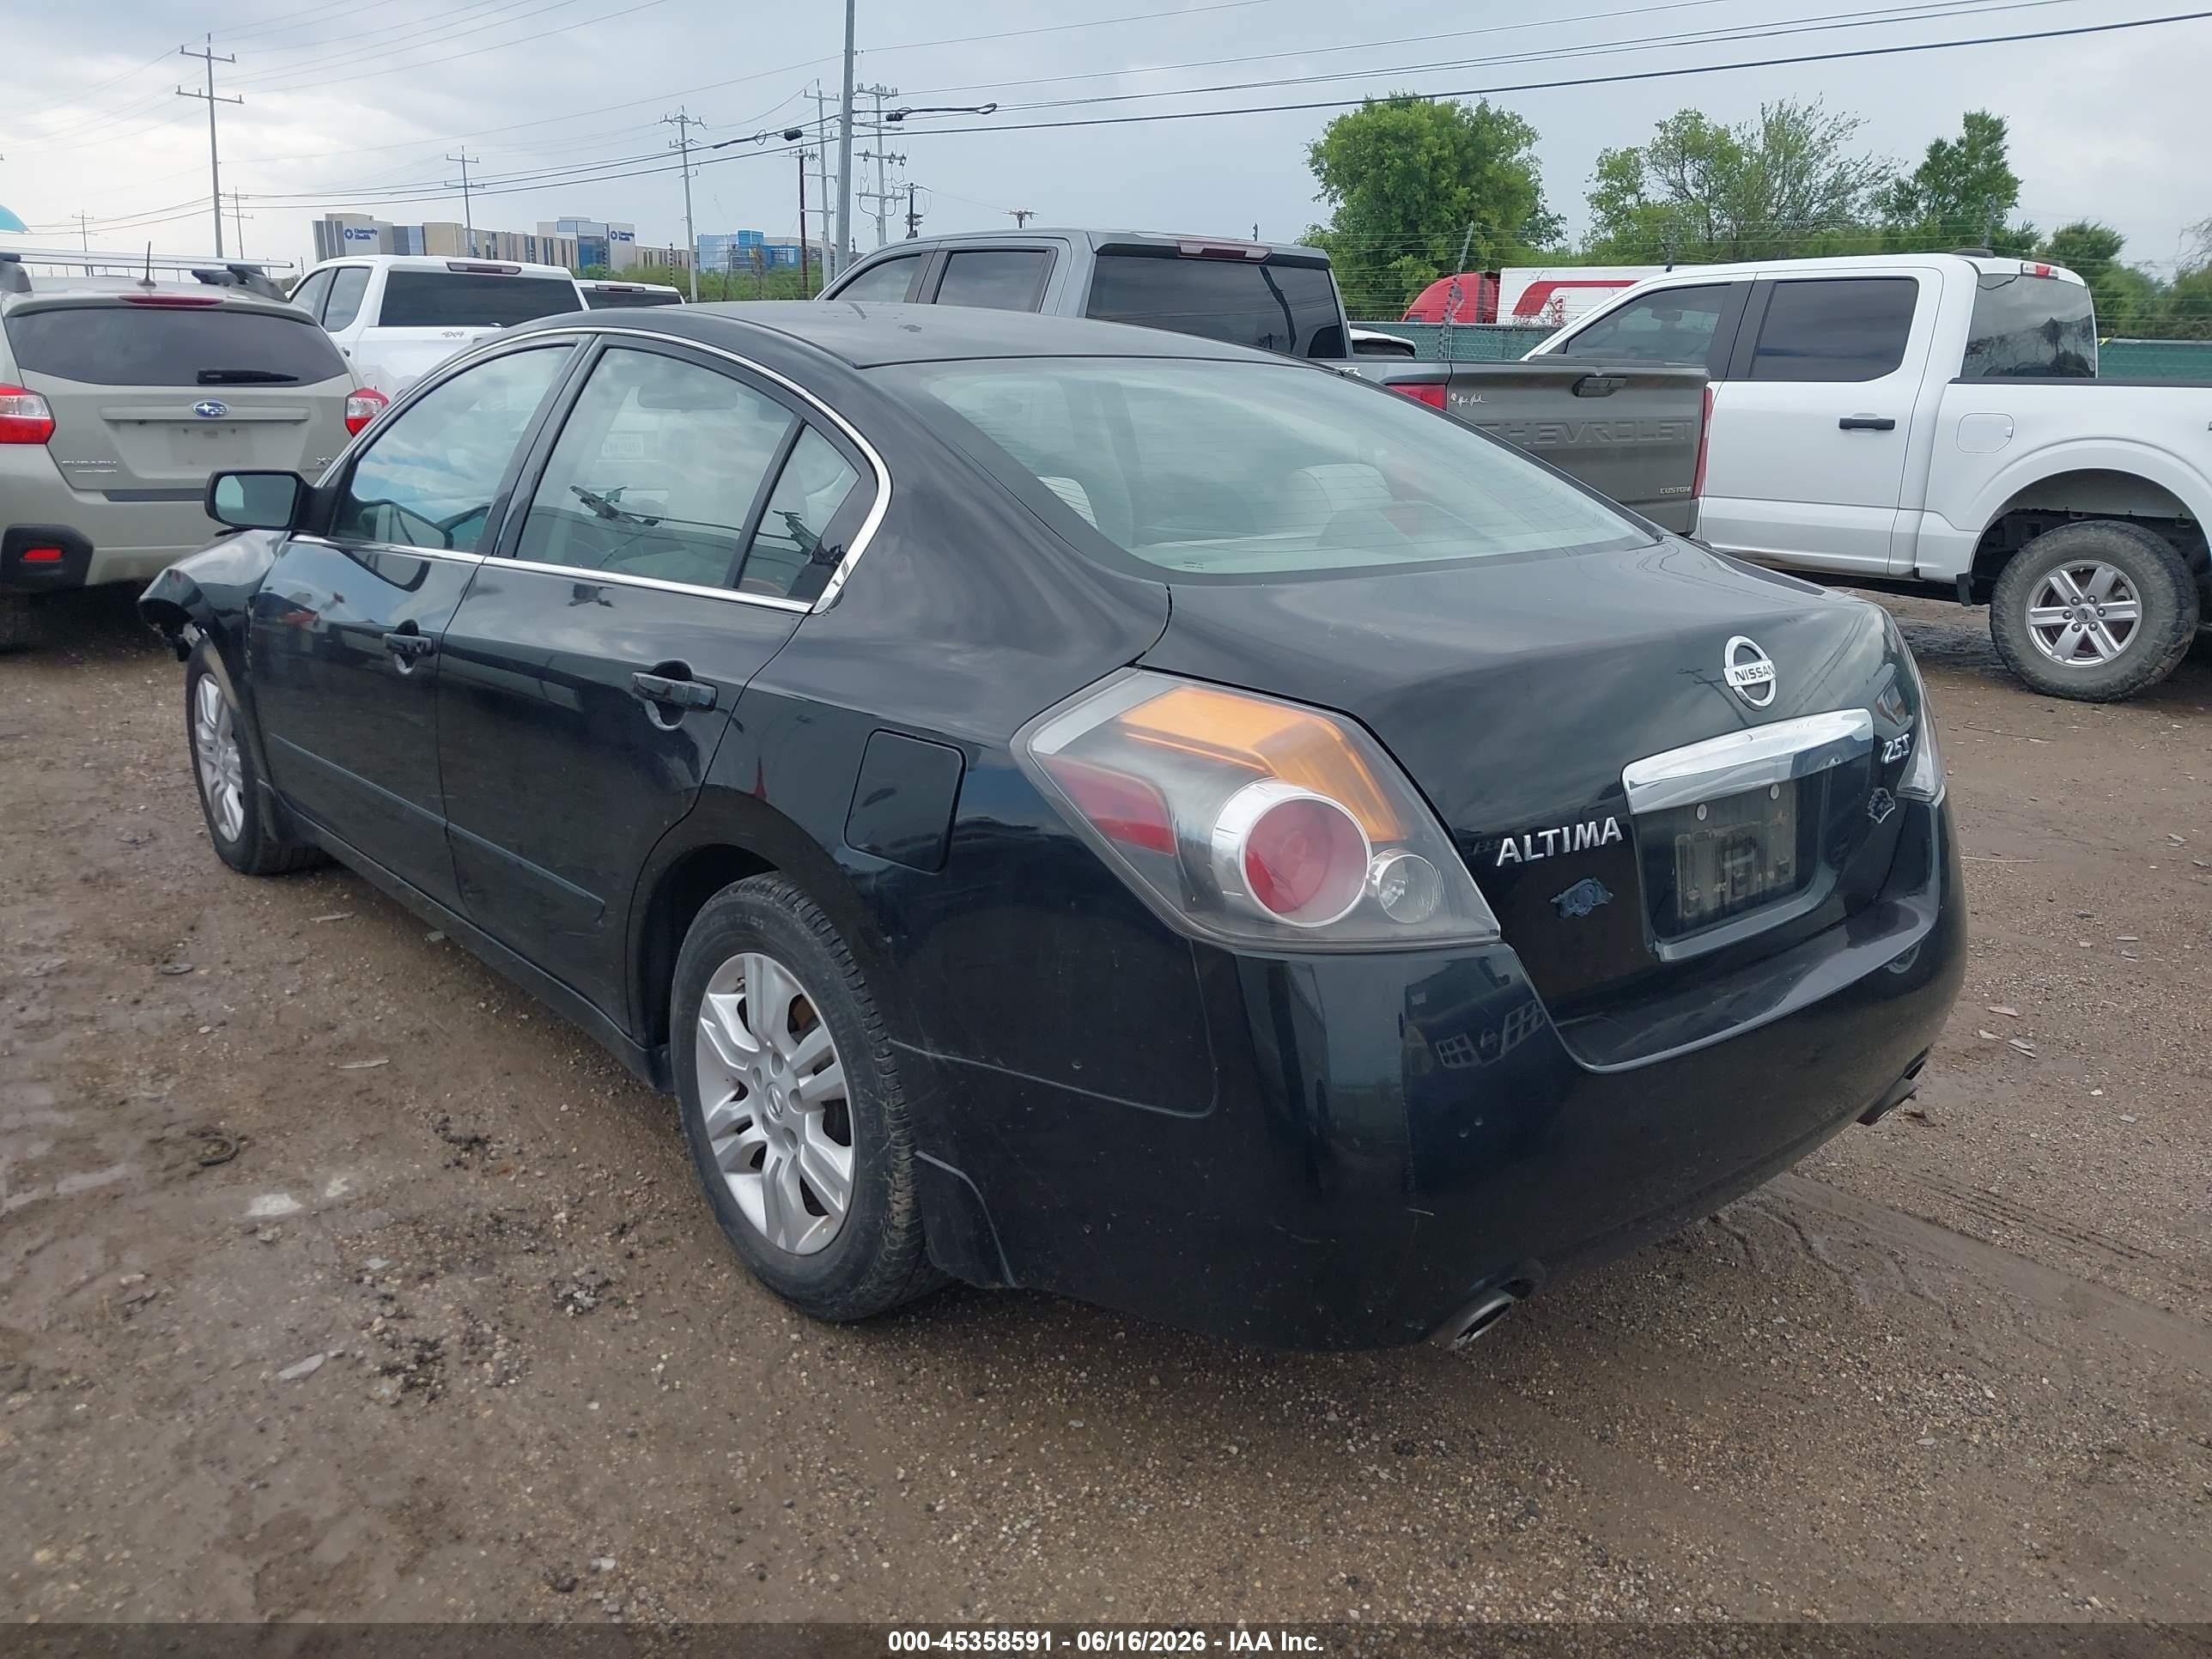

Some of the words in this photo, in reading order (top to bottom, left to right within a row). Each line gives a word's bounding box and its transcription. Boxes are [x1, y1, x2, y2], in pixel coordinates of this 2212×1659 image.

[1659, 486, 1692, 495] CUSTOM
[1734, 665, 1775, 682] NISSAN
[1496, 817, 1624, 867] ALTIMA
